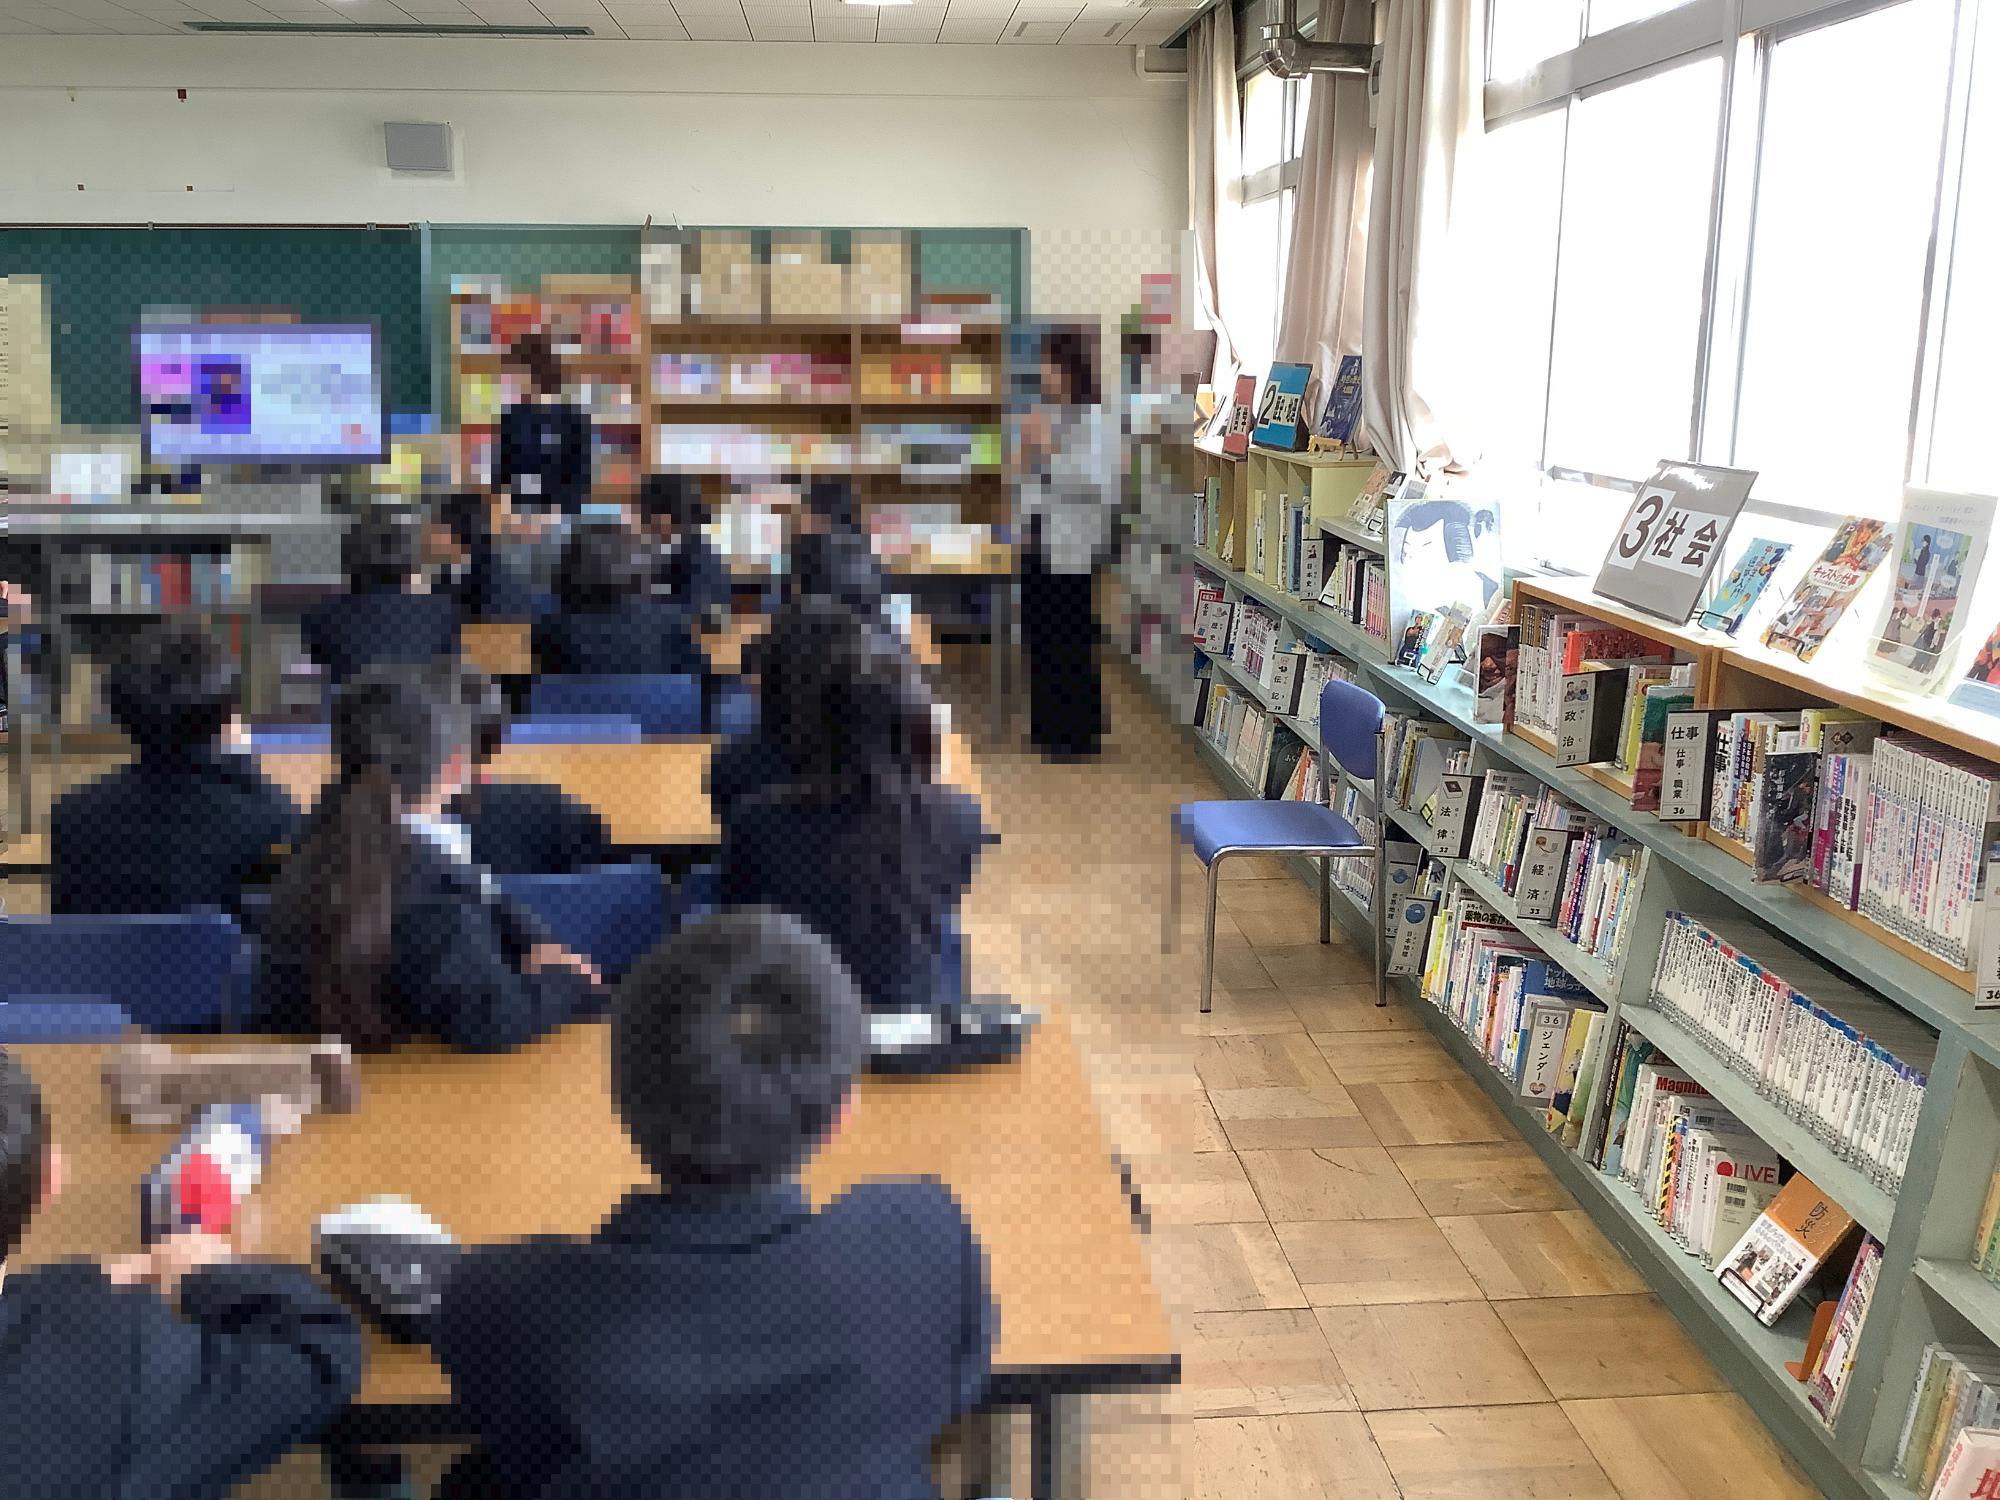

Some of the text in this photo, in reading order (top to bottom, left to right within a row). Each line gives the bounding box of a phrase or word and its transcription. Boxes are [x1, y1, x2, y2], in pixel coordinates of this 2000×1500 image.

[1259, 385, 1276, 425] 2
[1619, 495, 1664, 559] 3
[1652, 511, 1718, 568] 社会
[1271, 675, 1282, 700] 伝記
[1562, 709, 1576, 748] 政治
[1671, 726, 1699, 740] 仕事
[1673, 749, 1686, 799] 仕事・職業
[1437, 806, 1452, 840] 法律
[1673, 807, 1685, 815] 36
[1527, 864, 1545, 901] 経済
[1544, 1016, 1559, 1024] 36
[1536, 1031, 1553, 1081] ジェンダー
[1795, 1201, 1829, 1239] 防災
